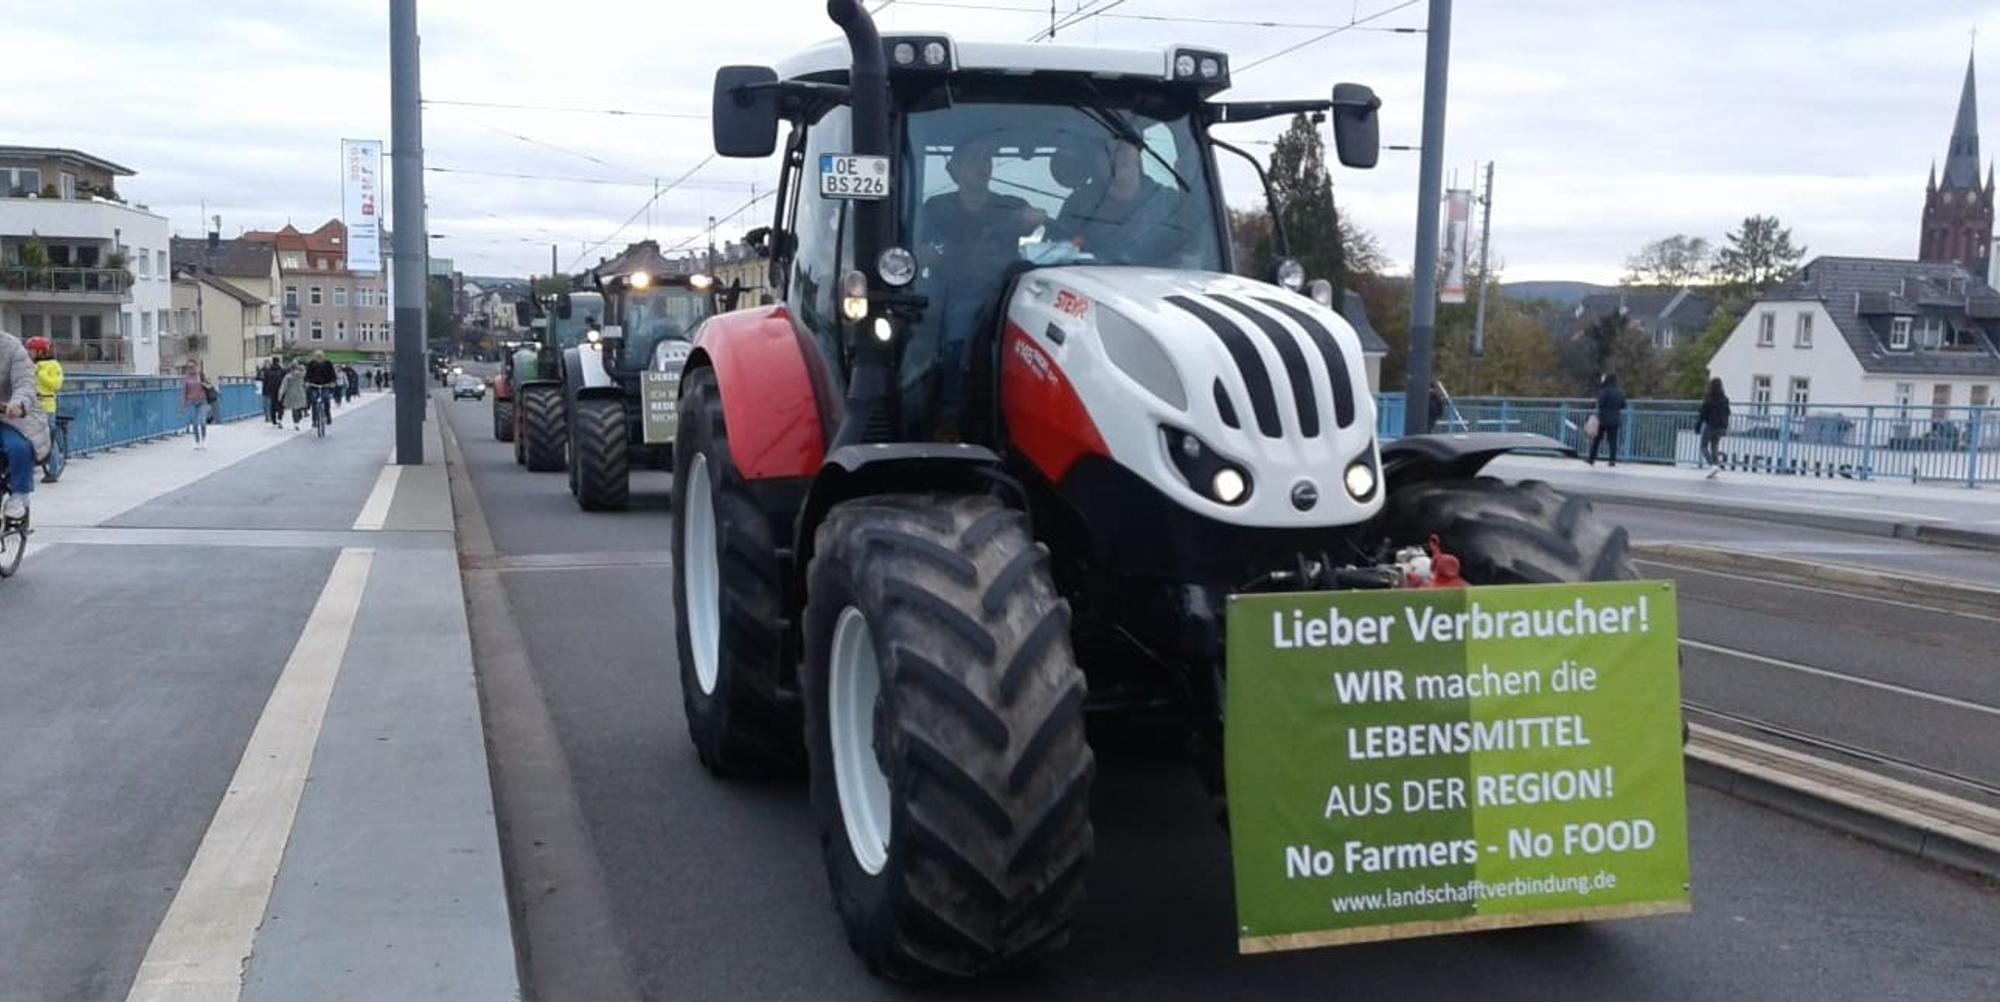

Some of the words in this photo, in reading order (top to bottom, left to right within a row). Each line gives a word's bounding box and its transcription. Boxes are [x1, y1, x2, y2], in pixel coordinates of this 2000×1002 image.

[827, 176, 848, 192] BS
[854, 177, 883, 193] 226
[837, 159, 857, 175] OE
[1273, 607, 1395, 648] Lieber
[1405, 595, 1649, 642] Verbraucher!
[1334, 670, 1406, 703] WIR
[1416, 664, 1540, 699] machen
[1551, 660, 1596, 692] die
[1348, 715, 1590, 759] LEBENSMITTEL
[1325, 783, 1392, 818] AUS
[1403, 778, 1466, 812] DER
[1477, 766, 1613, 806] REGION!
[1286, 845, 1334, 878] No
[1345, 840, 1478, 873] Farmers
[1508, 828, 1553, 859] No
[1563, 819, 1655, 854] FOOD
[1332, 872, 1616, 911] www.landschafftverbindung.de
